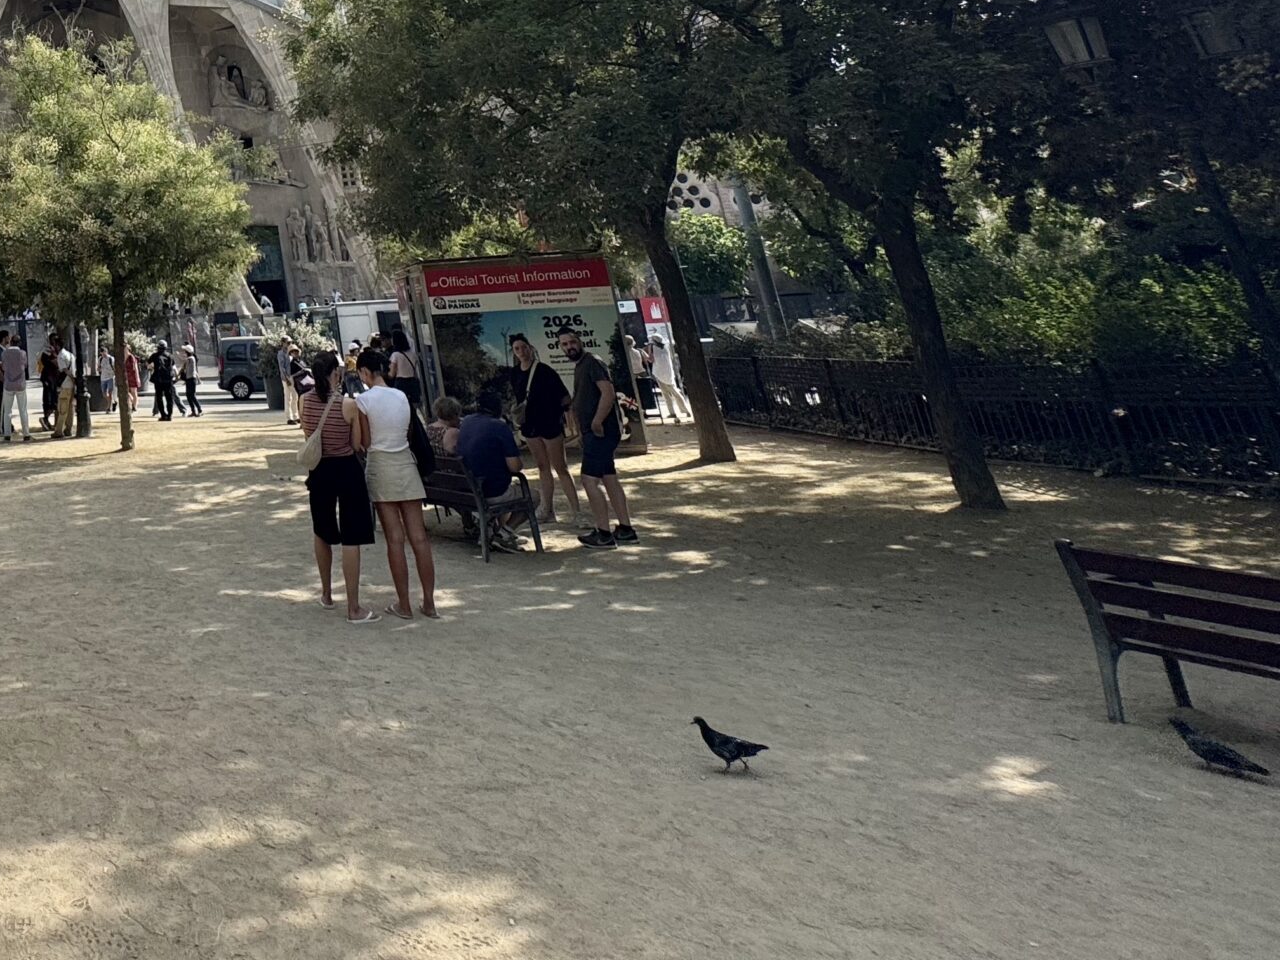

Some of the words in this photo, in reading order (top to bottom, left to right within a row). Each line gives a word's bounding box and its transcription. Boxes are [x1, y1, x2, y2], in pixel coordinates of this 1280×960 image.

[439, 275, 478, 288] Official
[480, 273, 519, 286] Tourist
[522, 268, 591, 282] Information
[447, 302, 481, 310] PANDAS
[542, 314, 587, 328] 2026,
